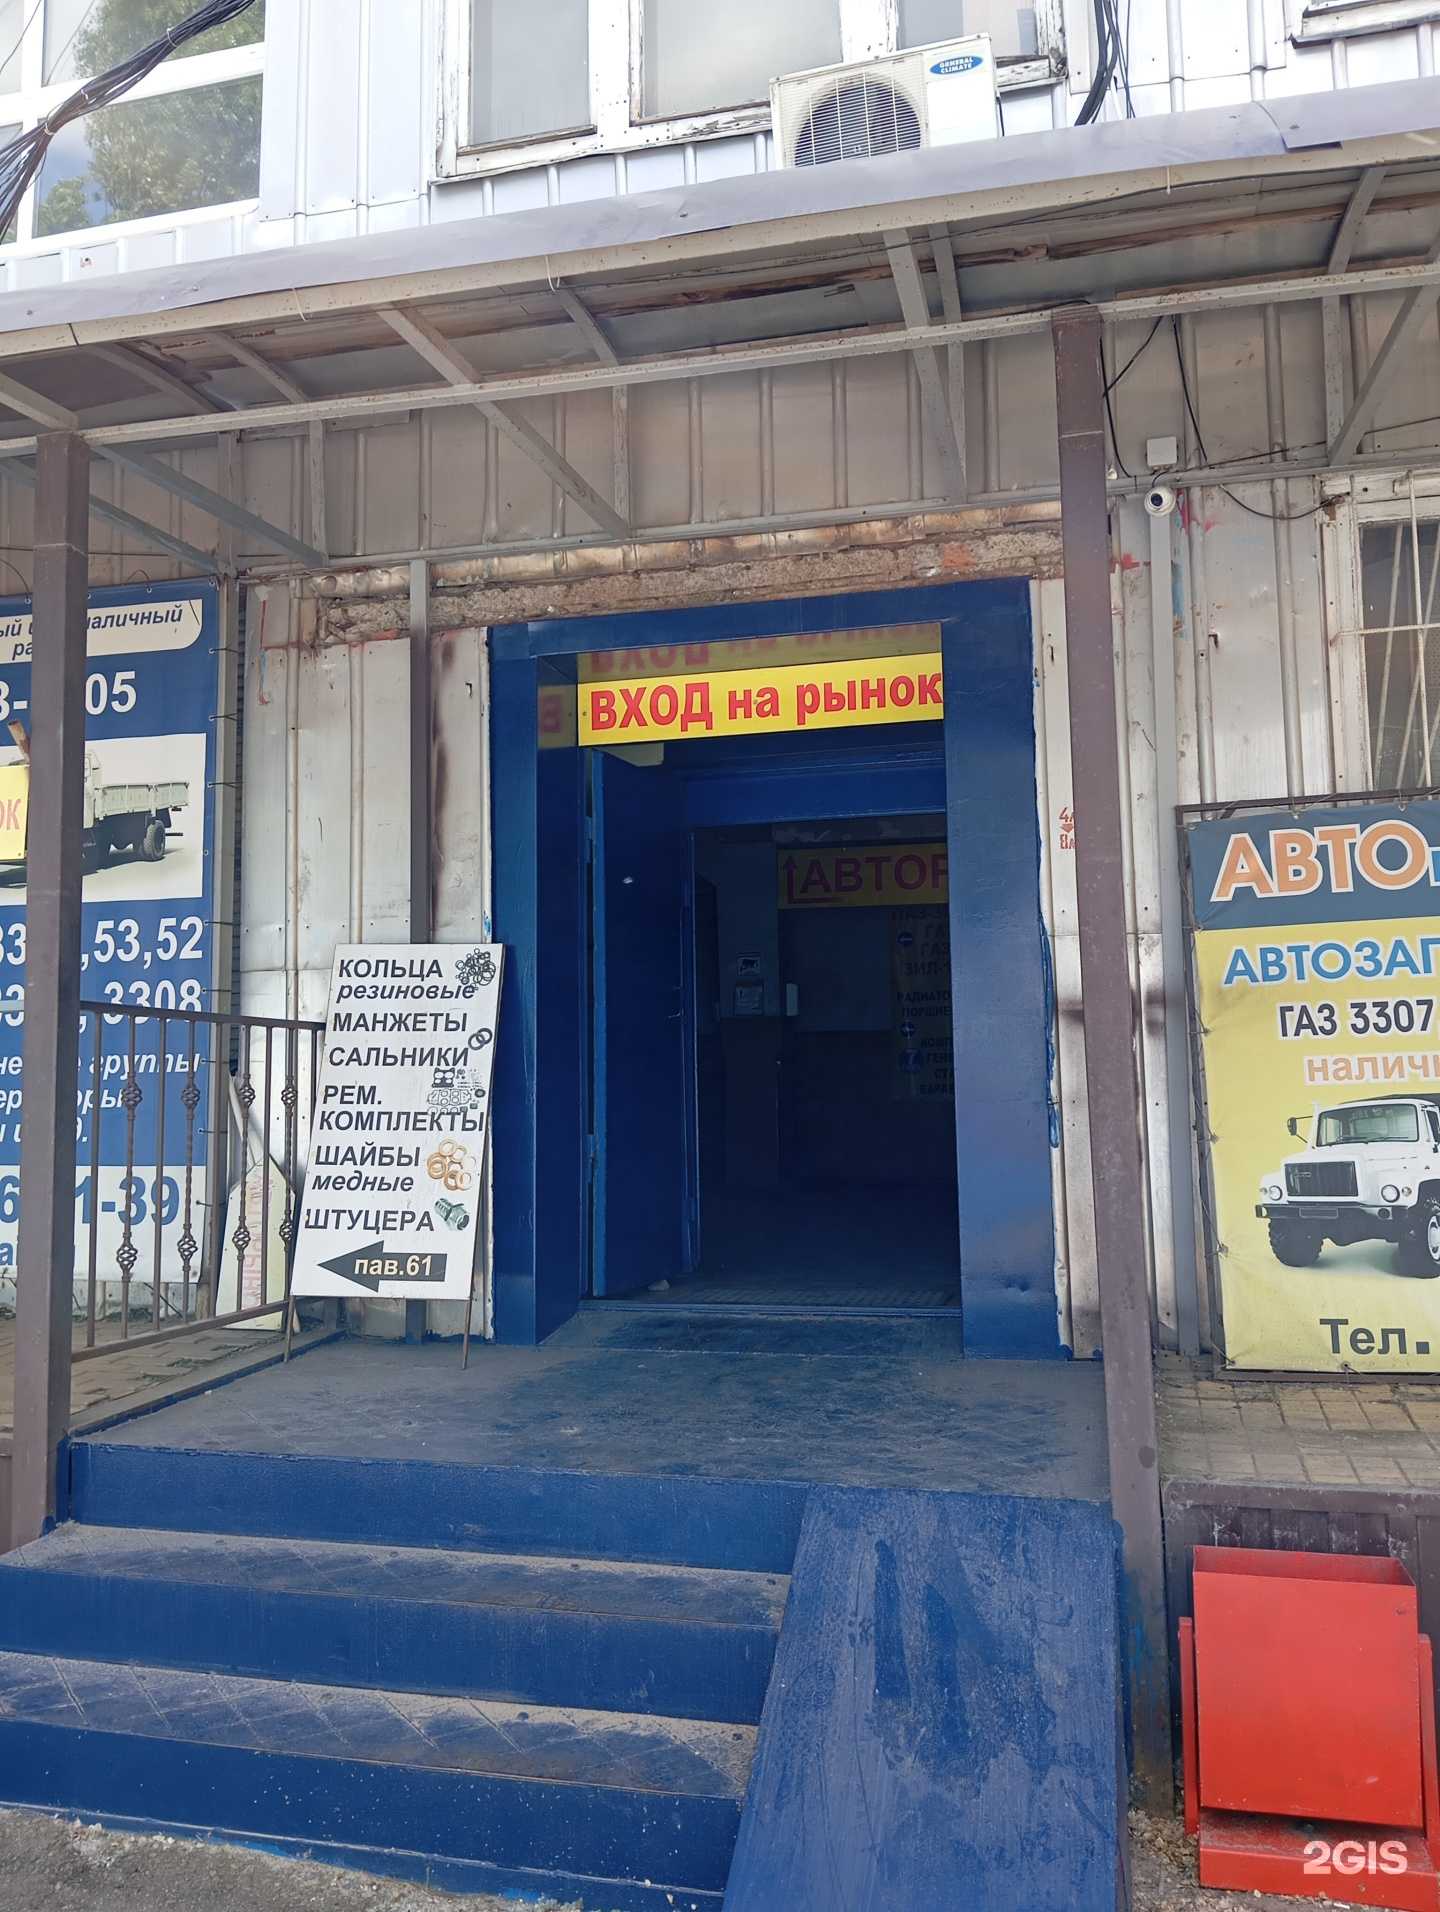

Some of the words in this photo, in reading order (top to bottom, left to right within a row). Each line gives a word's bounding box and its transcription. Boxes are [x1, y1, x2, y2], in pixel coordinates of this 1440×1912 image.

[940, 57, 973, 68] GENERAL
[940, 62, 972, 73] CLIMATE
[590, 682, 713, 732] ВХОД
[727, 687, 780, 720] на
[796, 672, 943, 725] рынок
[1210, 819, 1440, 902] АВТО
[338, 959, 444, 981] КОЛЬЦА
[335, 984, 476, 1004] резиновые
[332, 1012, 468, 1032] МАНЖЕТЫ
[1279, 1003, 1338, 1038] ГАЗ
[1350, 999, 1434, 1034] 3307
[328, 1047, 469, 1067] САЛЬНИКИ
[322, 1085, 383, 1105] РЕМ.
[319, 1110, 485, 1132] КОМПЛЕКТЫ
[315, 1141, 421, 1167] ШАЙБЫ
[311, 1170, 414, 1192] медные
[304, 1208, 435, 1235] ШТУЦЕРА
[353, 1255, 432, 1276] пав.61
[1319, 1318, 1431, 1355] Тел.
